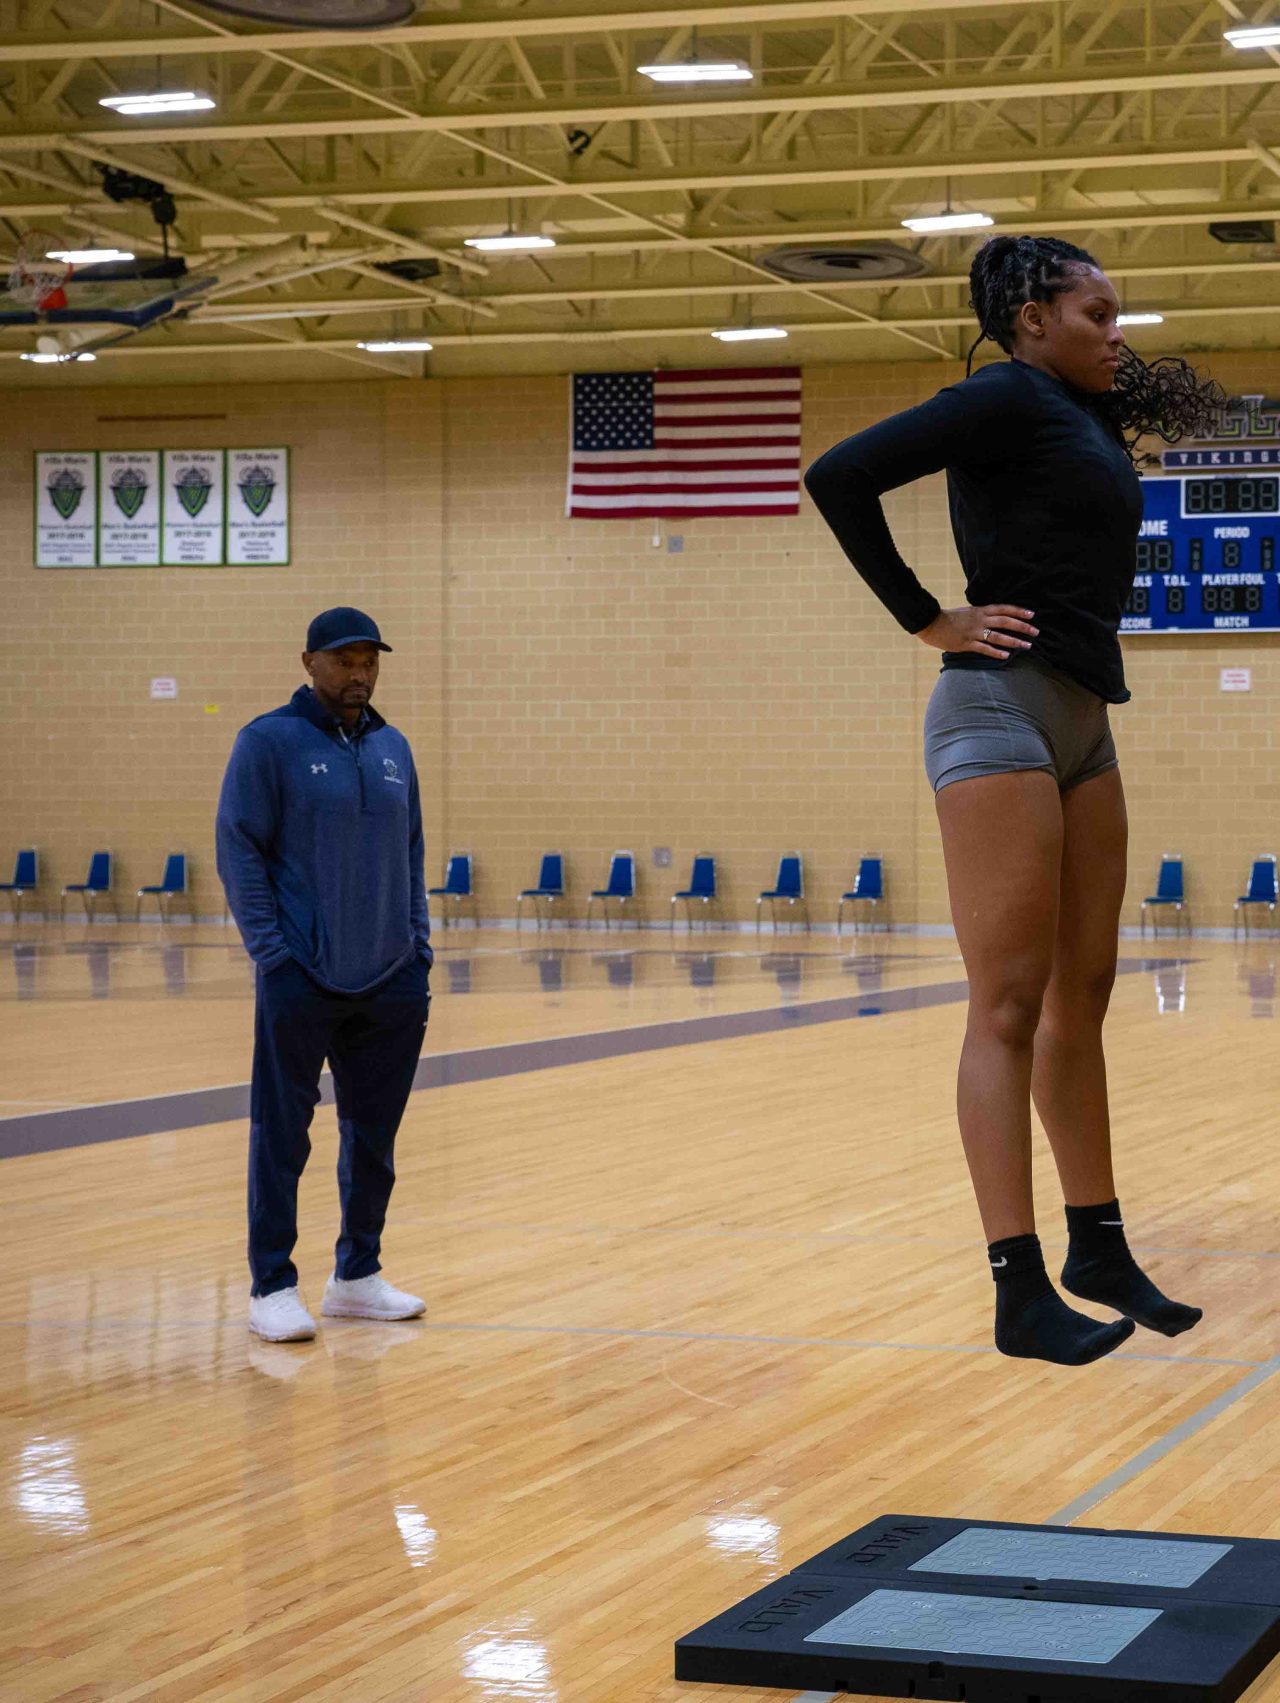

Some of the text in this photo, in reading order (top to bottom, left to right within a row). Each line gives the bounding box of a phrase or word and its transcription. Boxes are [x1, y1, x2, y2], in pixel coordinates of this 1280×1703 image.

[1138, 520, 1168, 536] OME
[1213, 526, 1250, 539] PERIOD
[1202, 573, 1239, 586] PLAYER
[1120, 617, 1152, 629] SCORE
[1214, 616, 1250, 628] MATCH
